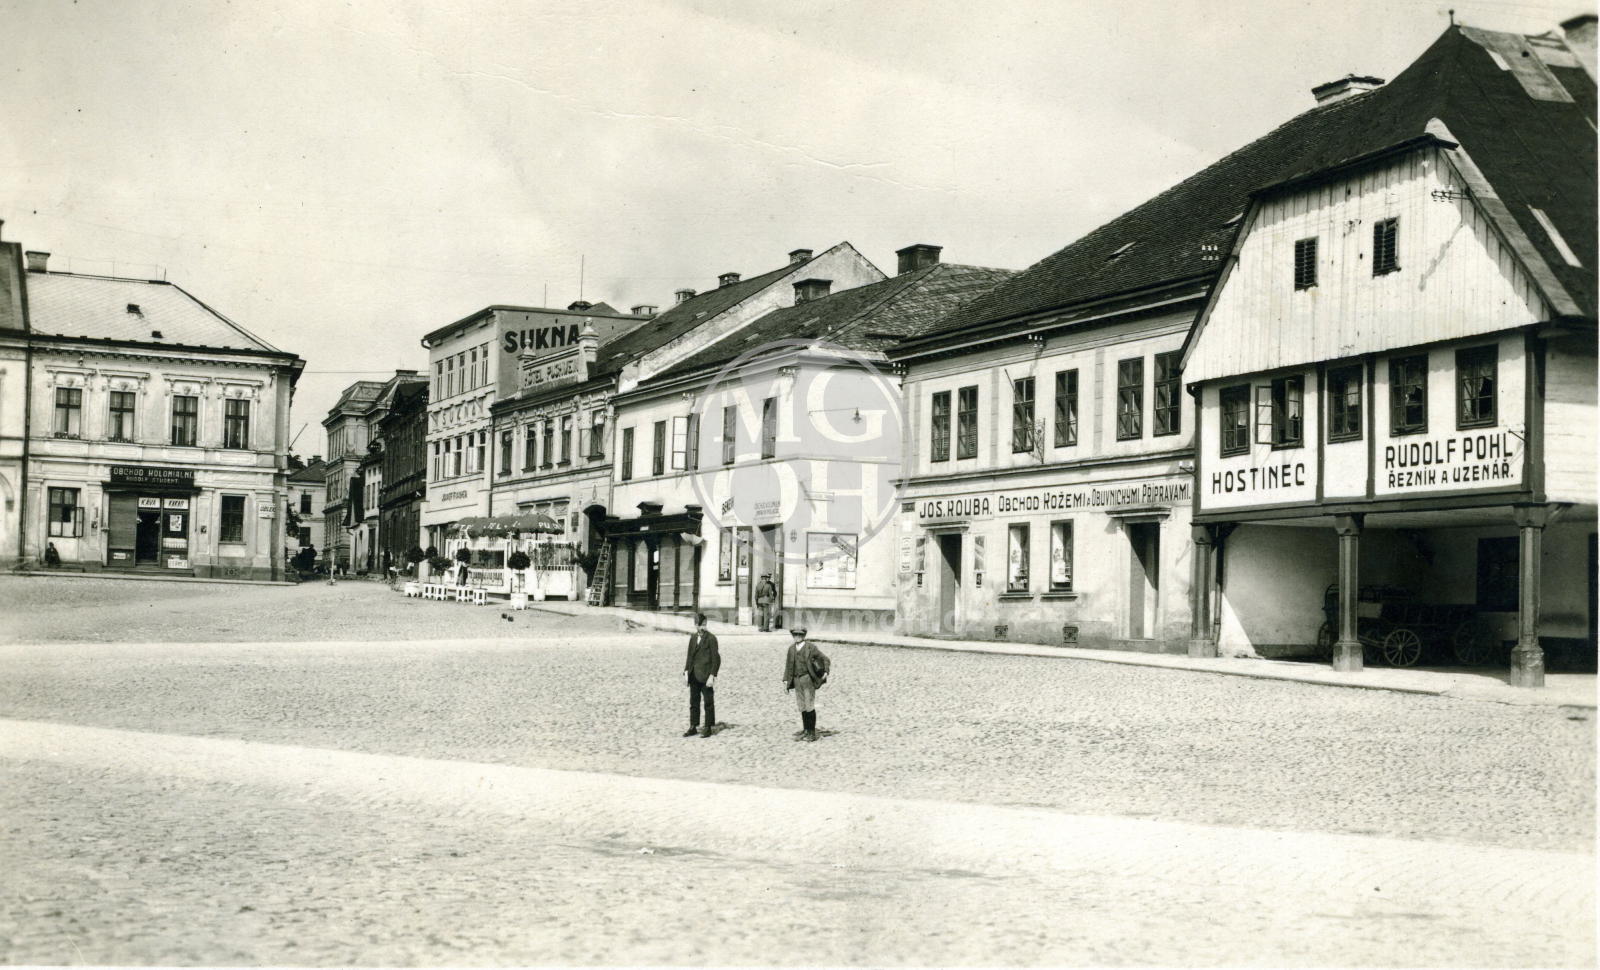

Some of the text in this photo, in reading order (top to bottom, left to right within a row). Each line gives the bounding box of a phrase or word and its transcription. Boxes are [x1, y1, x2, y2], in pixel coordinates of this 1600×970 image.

[504, 324, 581, 353] SUKNA
[1385, 432, 1513, 470] RUDOLF POHL
[113, 467, 144, 477] OBCHOD
[1212, 462, 1305, 495] HOSTINEC
[1388, 458, 1514, 488] ŘEZNÍK A UZENÁŘ.
[919, 500, 946, 519] JOS.
[947, 497, 993, 517] ROUBA.
[998, 494, 1040, 513] OBCHOD
[1043, 491, 1086, 510] KOŽEMI
[1091, 485, 1140, 507] OBUVNICKÝMI
